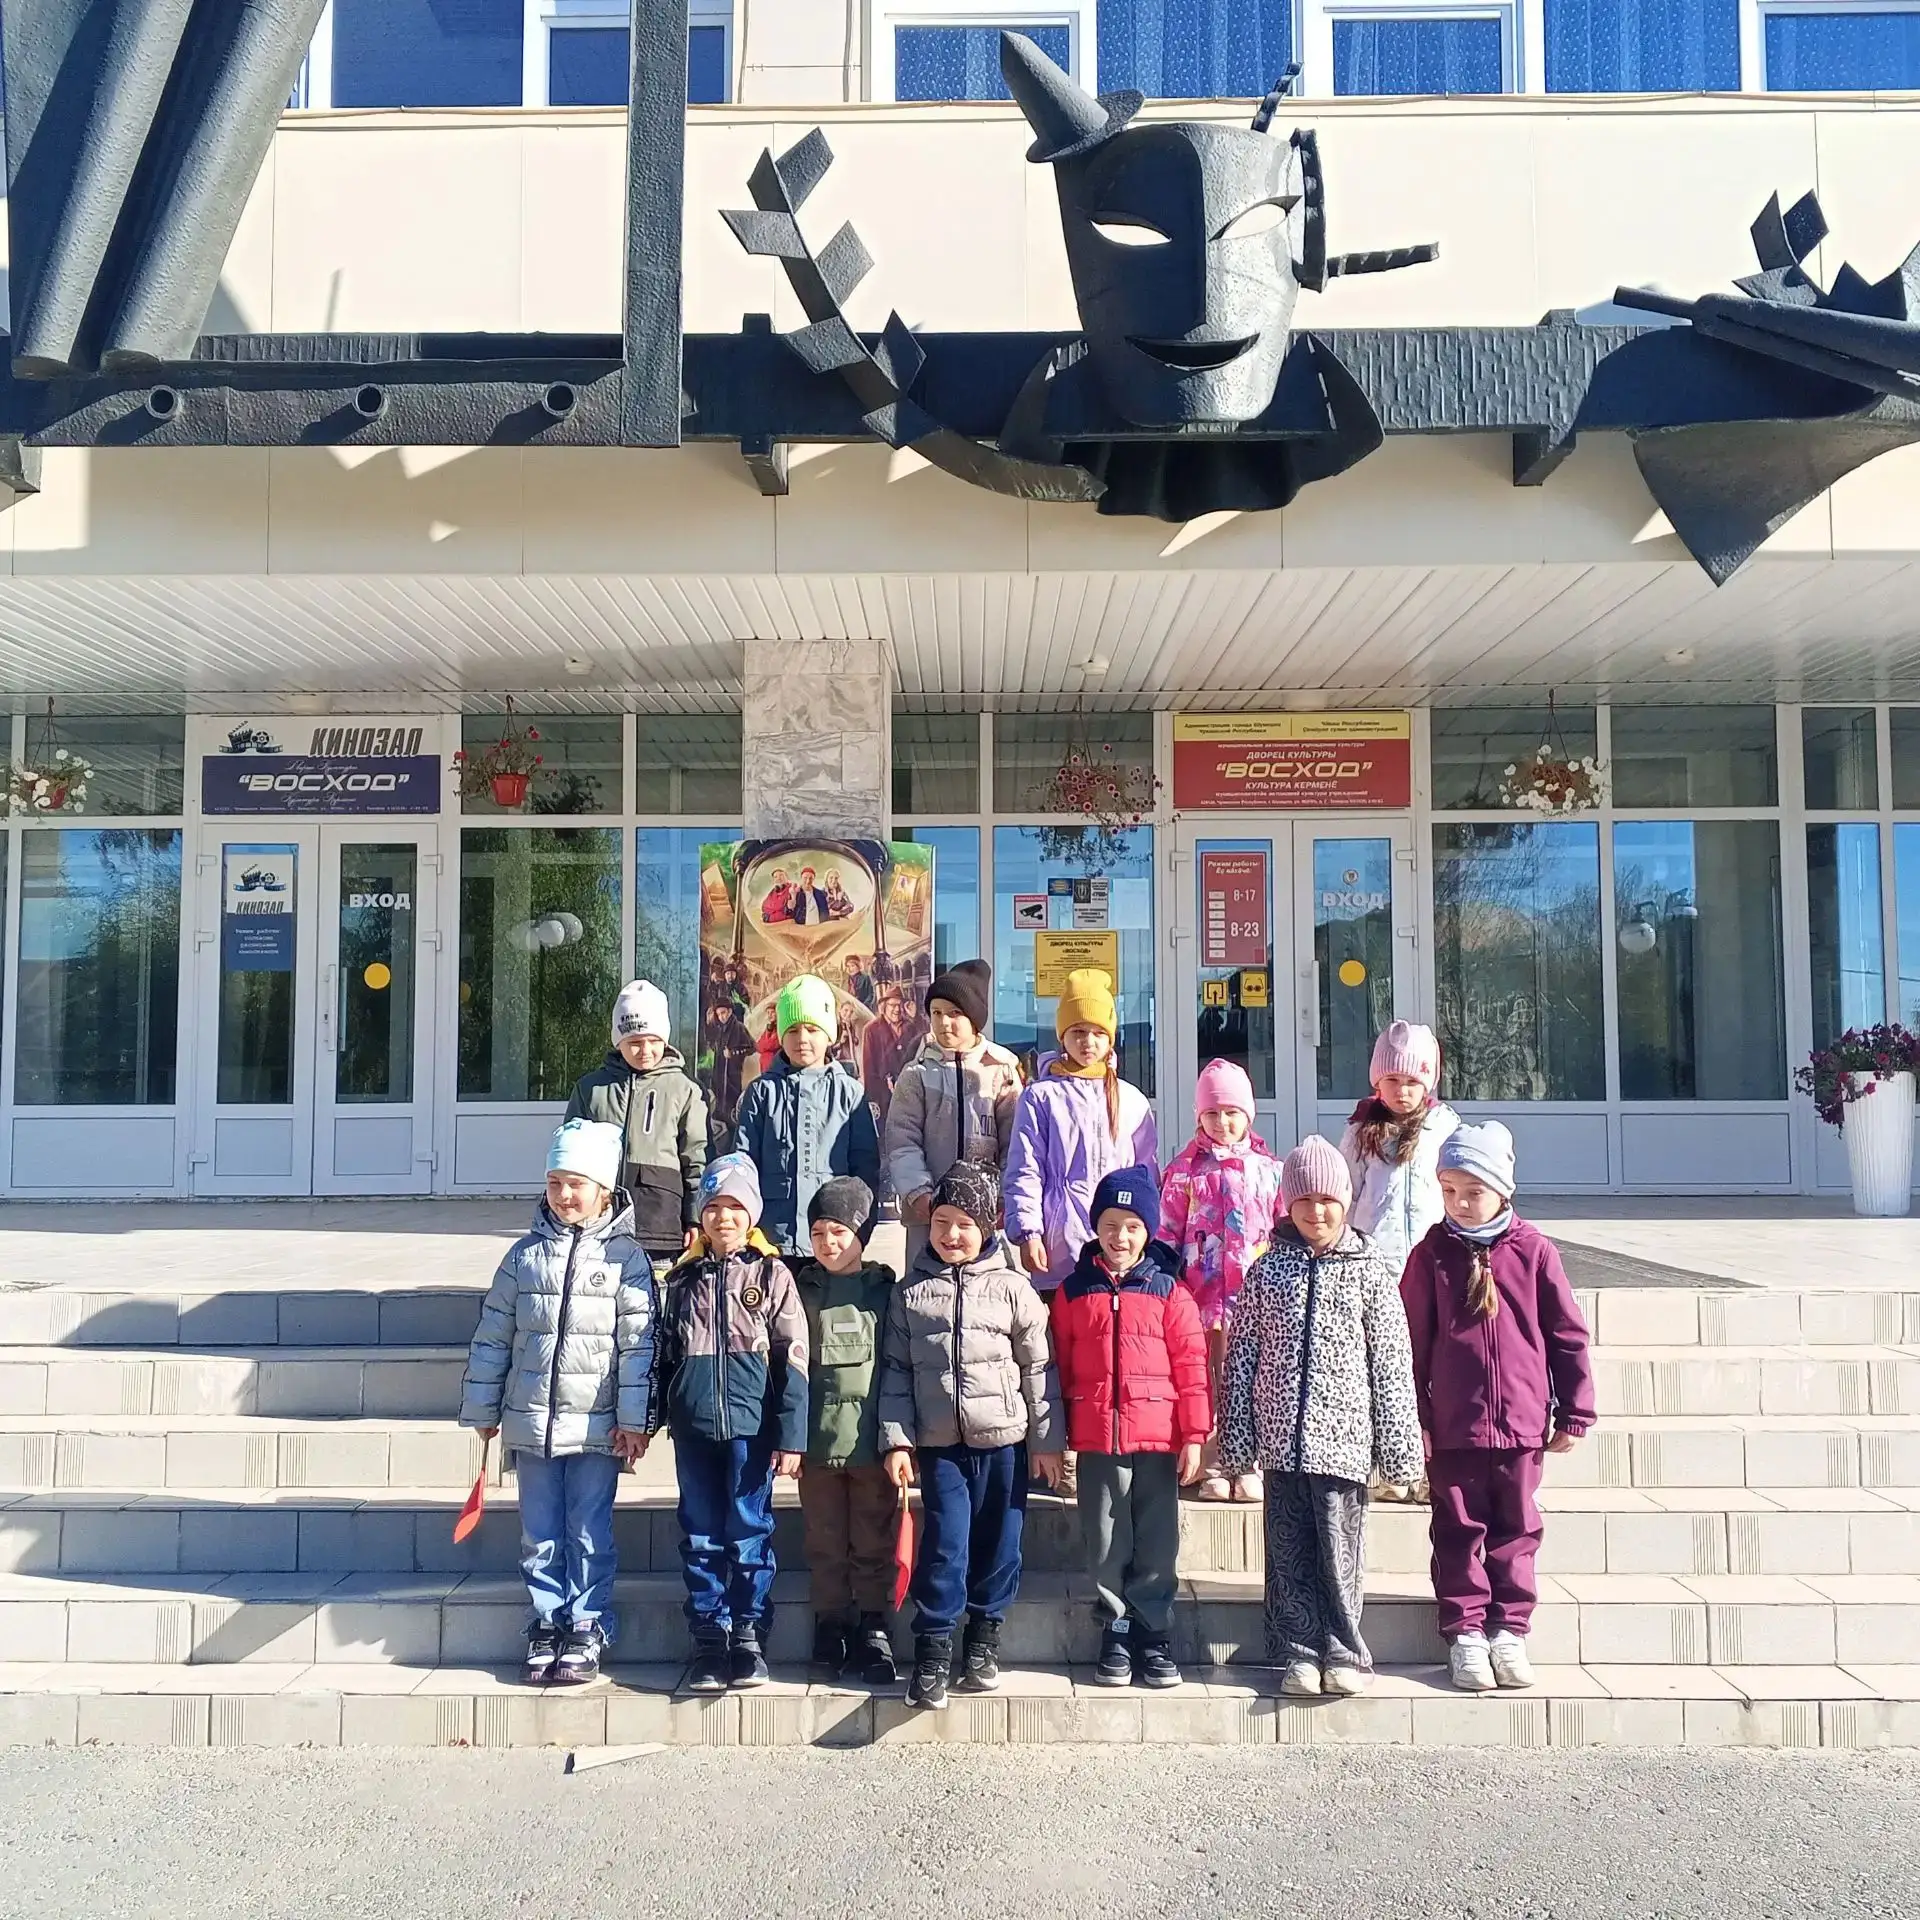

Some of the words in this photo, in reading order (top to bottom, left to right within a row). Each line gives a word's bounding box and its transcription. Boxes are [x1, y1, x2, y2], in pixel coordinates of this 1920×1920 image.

[308, 728, 423, 757] КИНОЗАЛ
[1246, 751, 1286, 760] ДВОРЕЦ
[1288, 751, 1337, 759] КУЛЬТУРЫ
[1245, 782, 1292, 790] КУЛЬТУРА
[349, 893, 411, 910] ВХОД
[1233, 889, 1256, 902] 8-17
[1322, 892, 1384, 909] ВХОД
[234, 901, 284, 915] КИНОЗАЛ
[1230, 921, 1260, 937] 8-23
